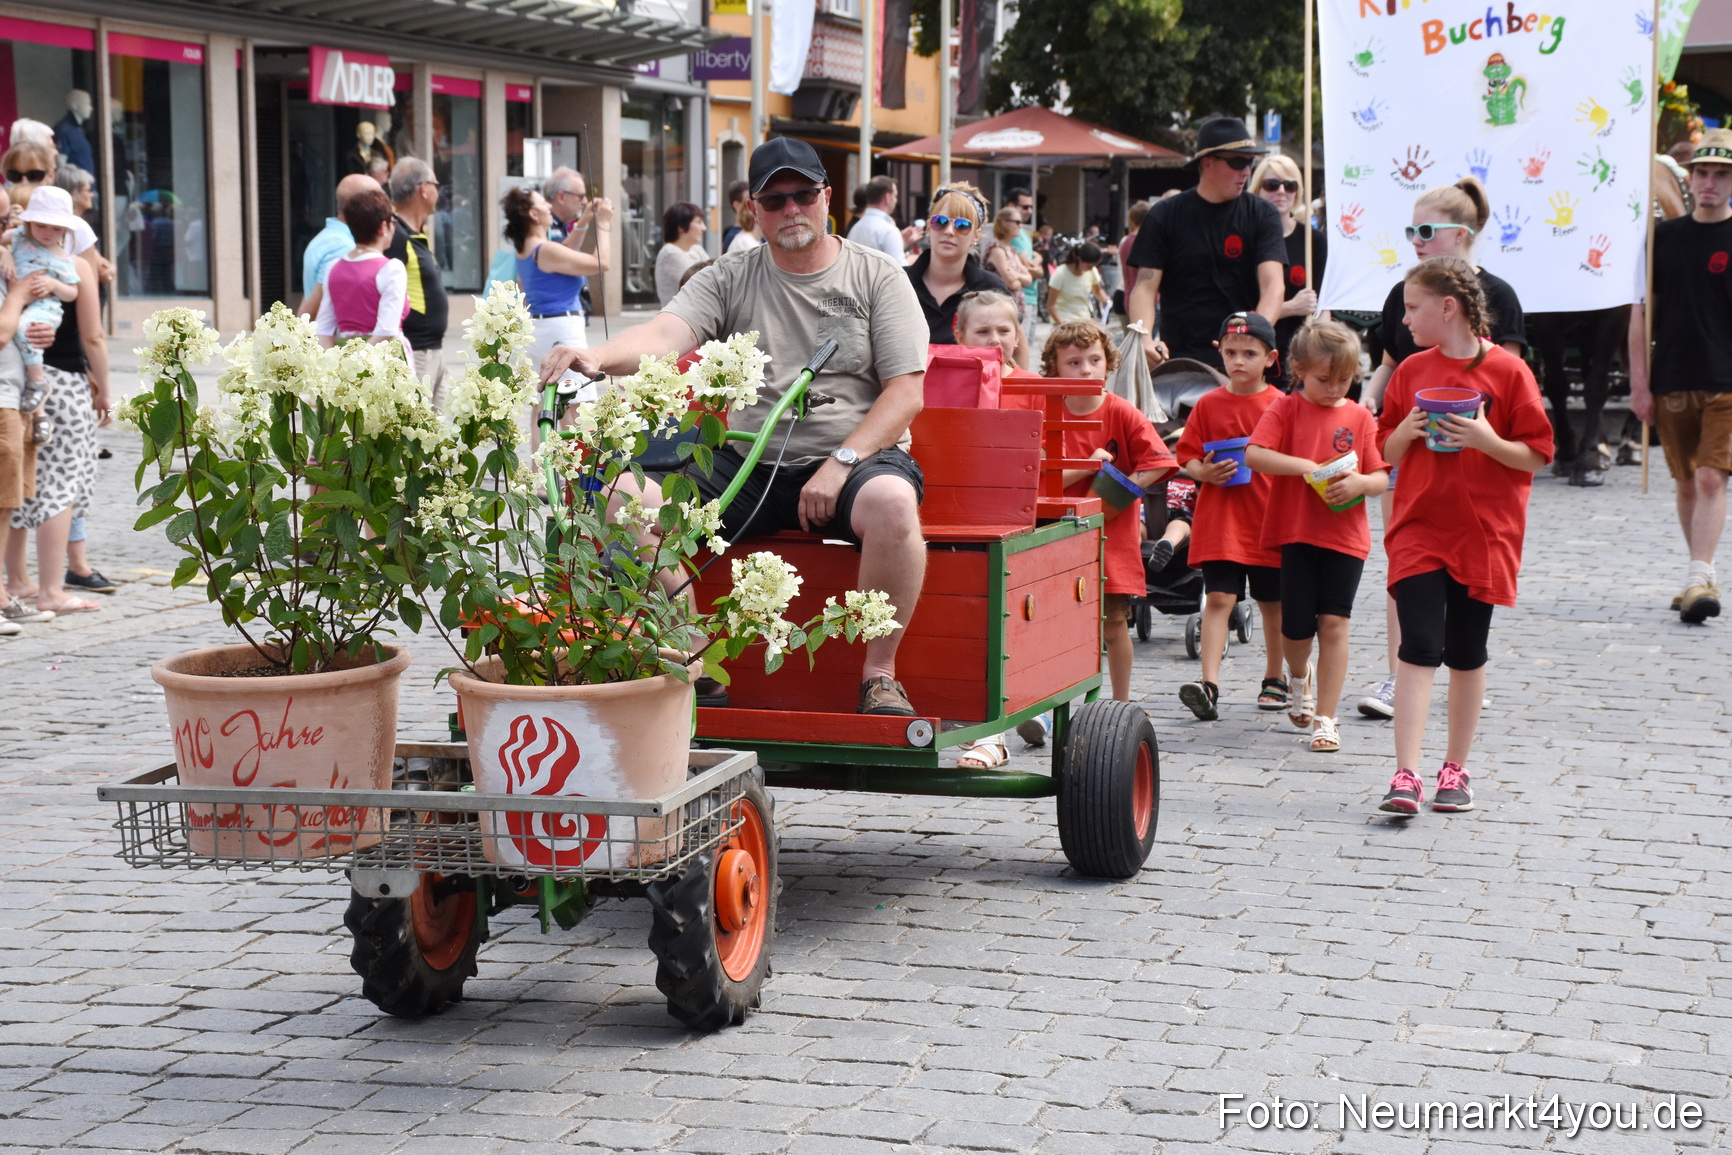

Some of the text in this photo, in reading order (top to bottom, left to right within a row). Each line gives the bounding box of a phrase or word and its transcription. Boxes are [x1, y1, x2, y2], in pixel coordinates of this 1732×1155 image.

[1421, 2, 1566, 55] Buchberg
[329, 51, 396, 107] ADLER
[695, 50, 751, 72] liberty
[175, 696, 324, 787] 110 Jahre
